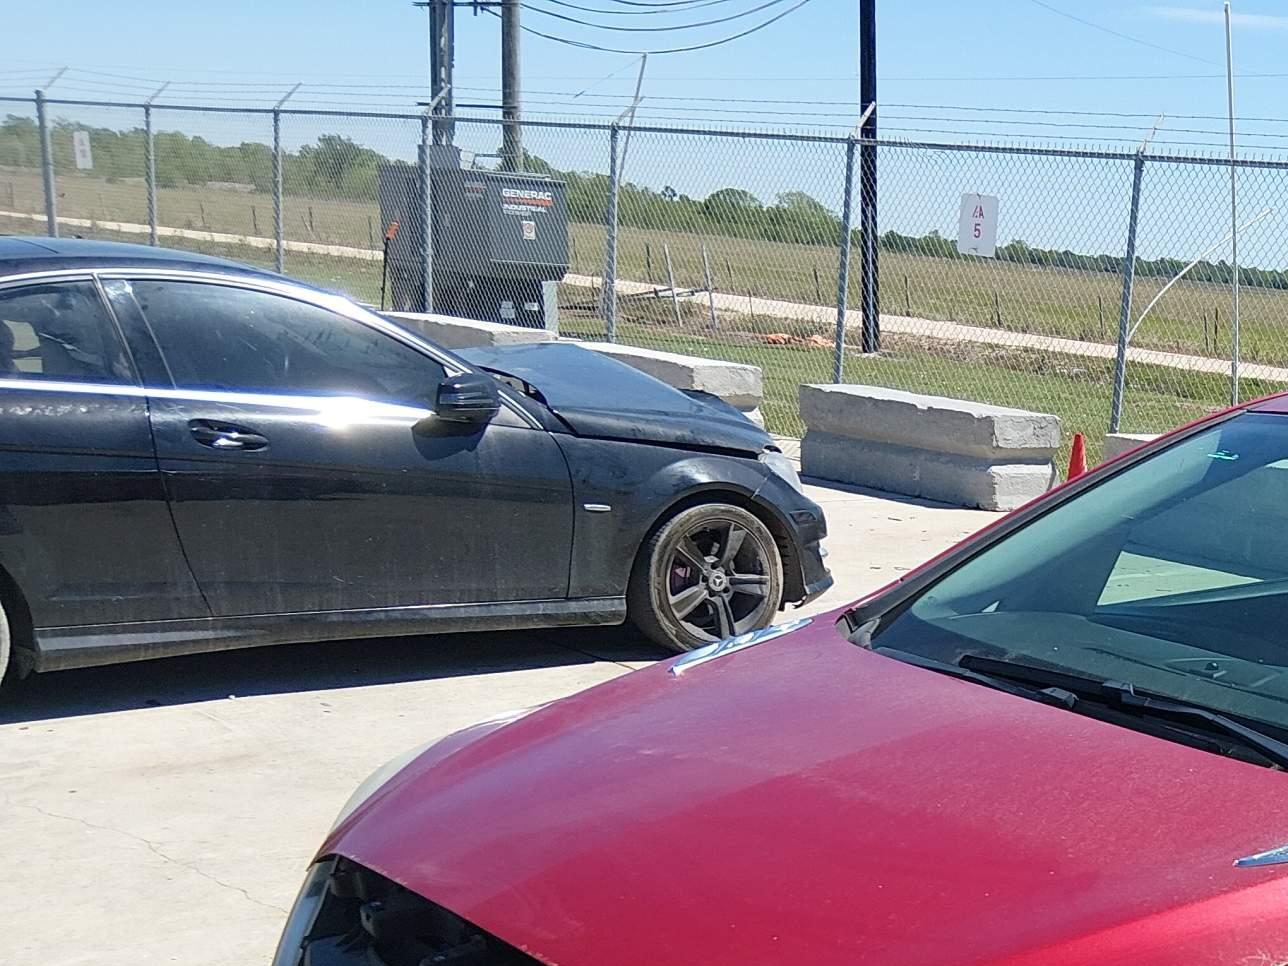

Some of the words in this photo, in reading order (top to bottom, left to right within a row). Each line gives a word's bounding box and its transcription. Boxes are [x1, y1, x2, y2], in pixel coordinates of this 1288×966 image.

[502, 188, 552, 200] GENERAC
[503, 204, 547, 213] INDUSTRIAL
[974, 223, 981, 238] 5
